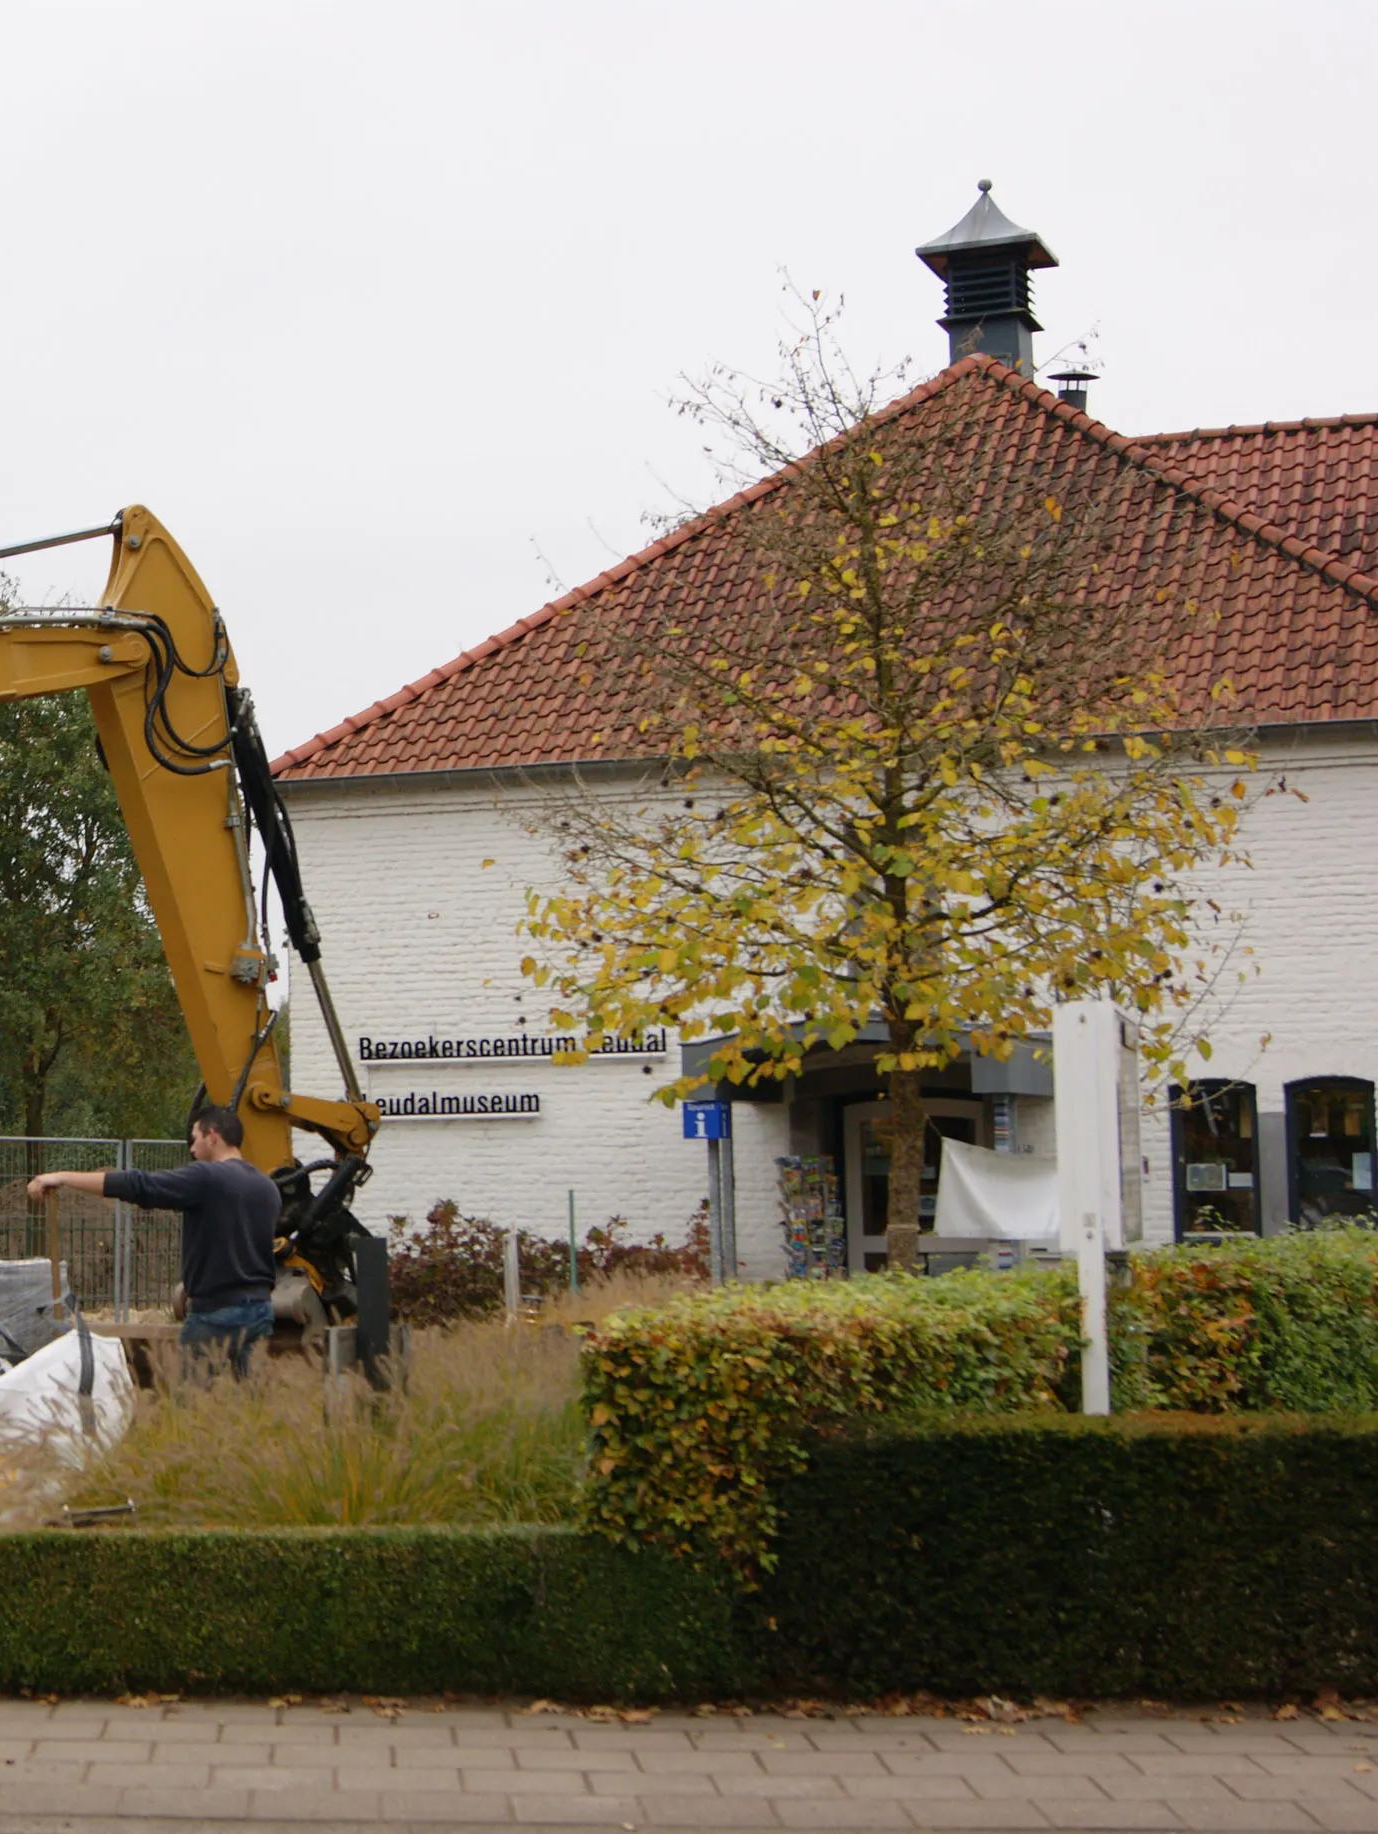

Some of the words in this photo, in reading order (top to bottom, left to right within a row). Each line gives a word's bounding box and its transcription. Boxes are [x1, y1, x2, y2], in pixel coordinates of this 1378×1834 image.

[359, 1033, 577, 1060] Bezoekerscentrum
[586, 1028, 666, 1054] eudal
[362, 1091, 539, 1116] eudalmuseum
